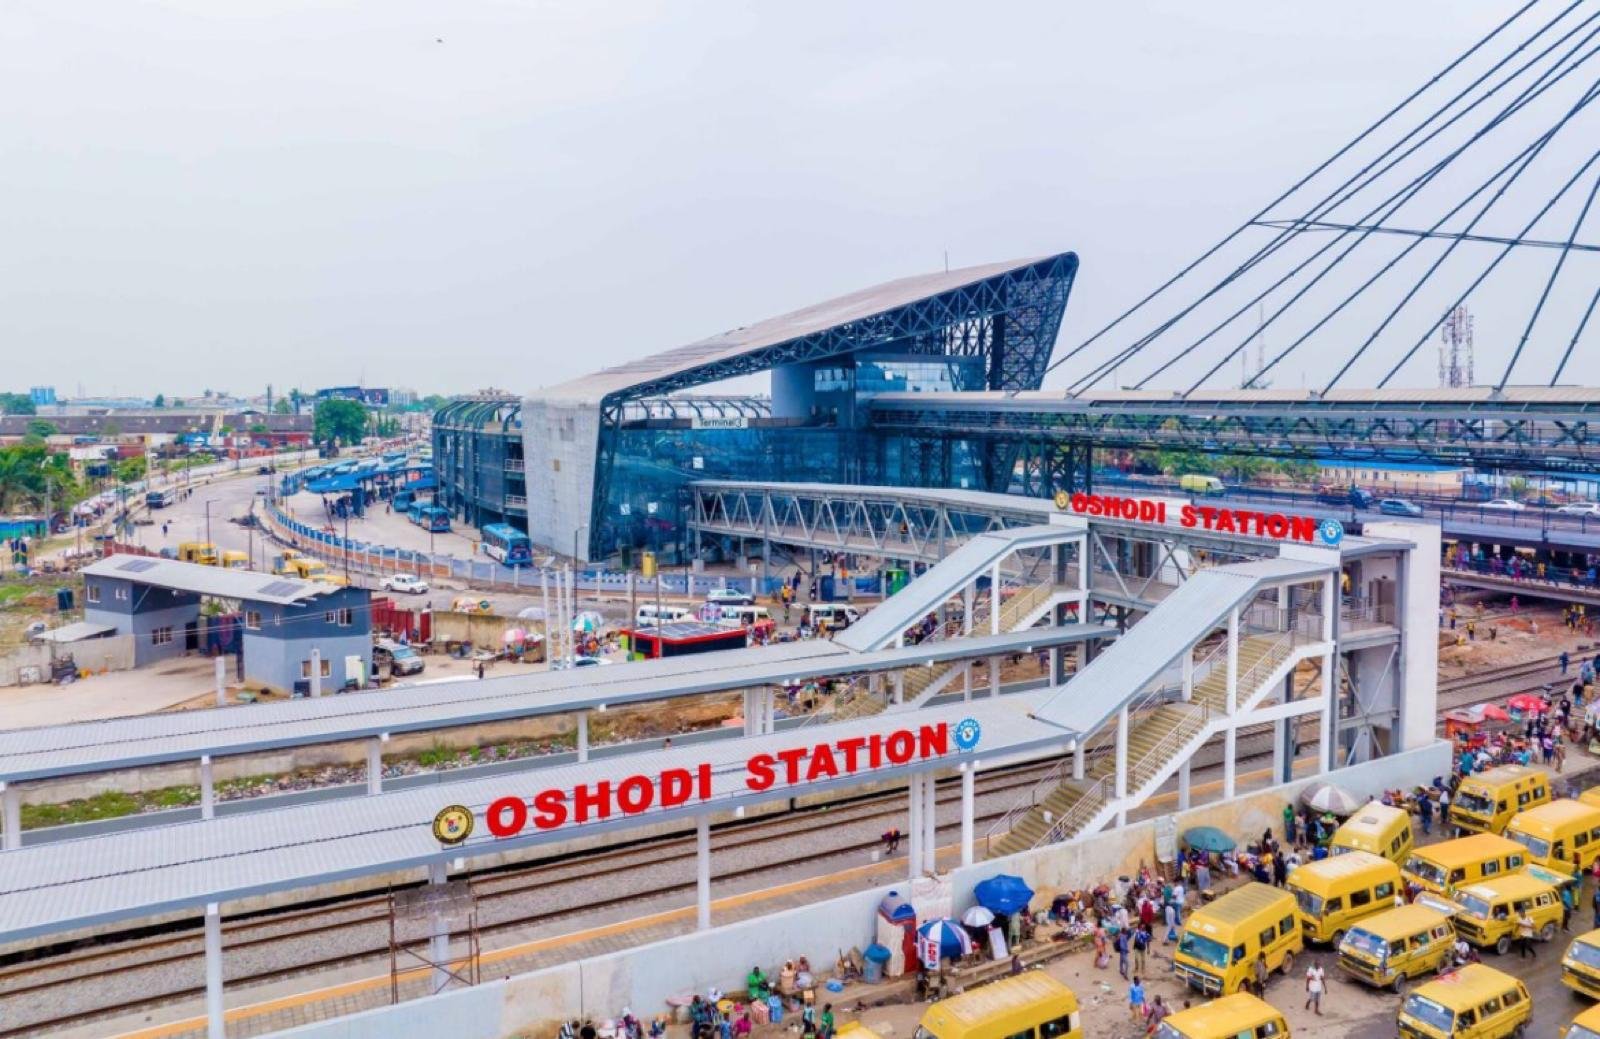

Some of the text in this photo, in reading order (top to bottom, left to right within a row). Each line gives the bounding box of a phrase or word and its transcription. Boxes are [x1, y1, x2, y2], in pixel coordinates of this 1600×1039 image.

[698, 418, 734, 427] Terminal
[1071, 492, 1166, 523] OSHODI
[1180, 505, 1316, 542] STATION
[485, 763, 712, 838] OSHODI
[745, 722, 948, 792] STATION
